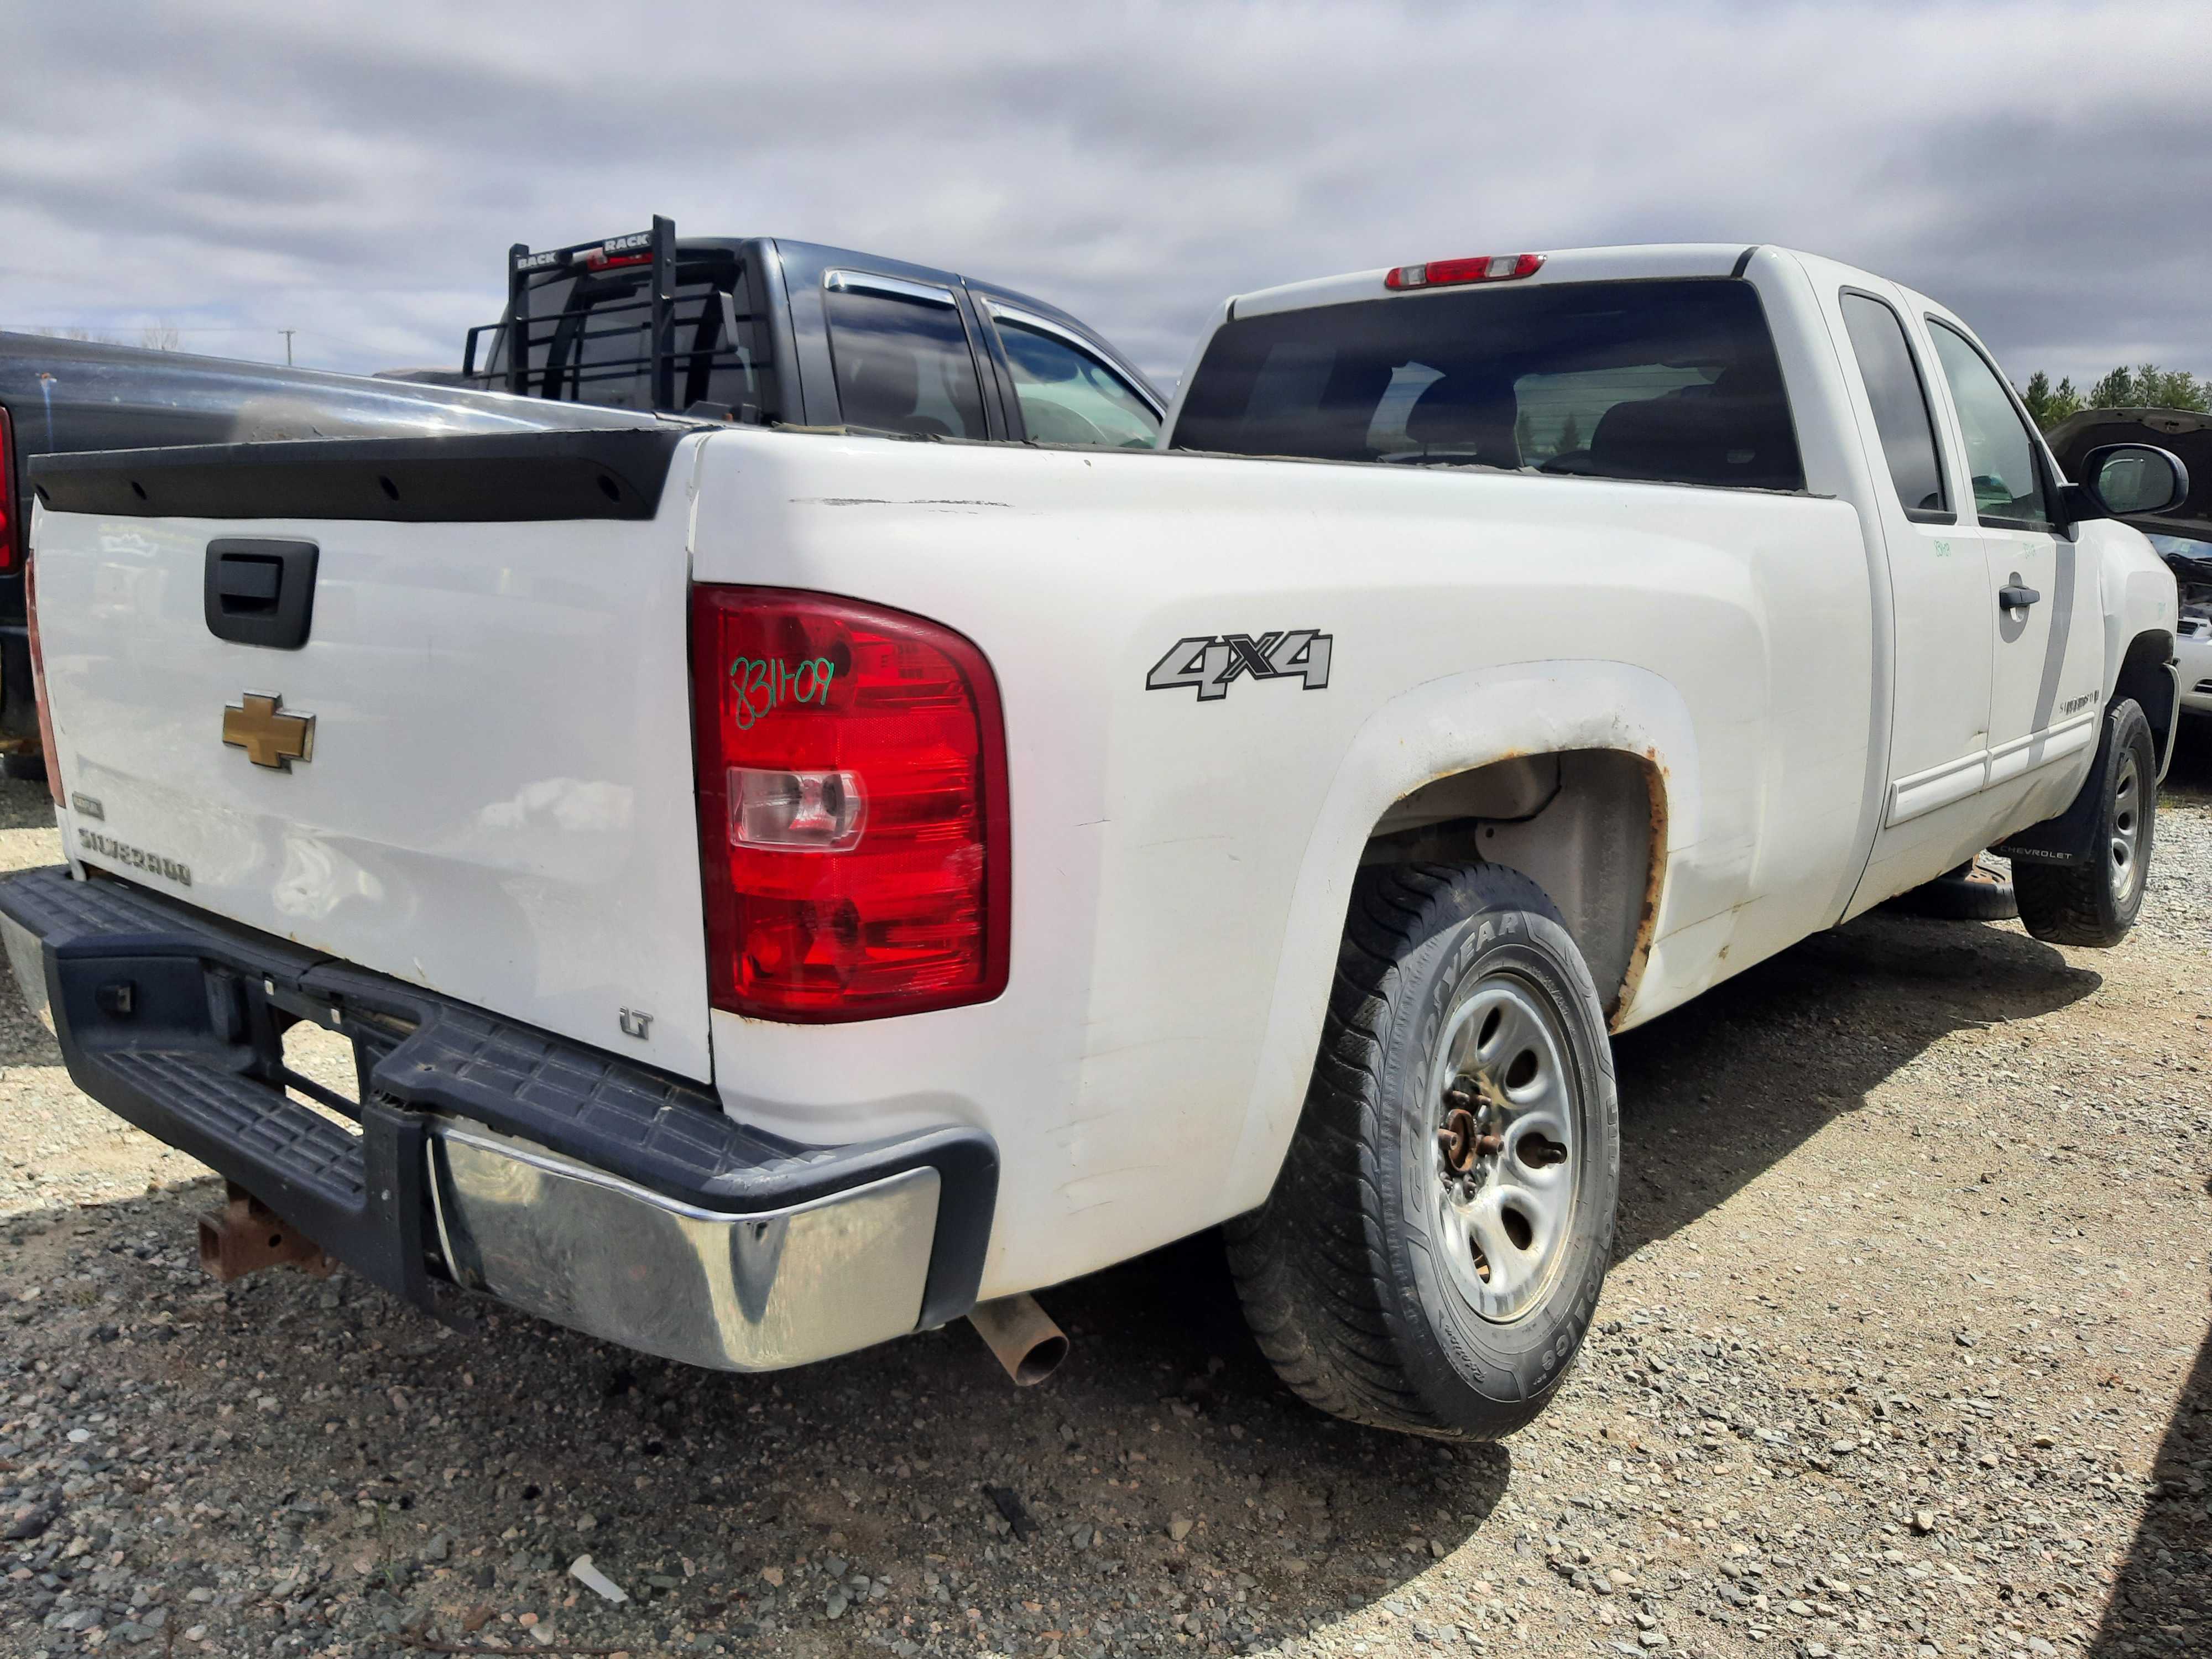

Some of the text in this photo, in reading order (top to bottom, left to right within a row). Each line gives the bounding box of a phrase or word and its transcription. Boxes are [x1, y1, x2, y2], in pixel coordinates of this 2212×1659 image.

[517, 233, 650, 269] BACK RACK
[78, 828, 191, 887] SILVERADO
[2000, 846, 2073, 859] CHEVROLET
[619, 1005, 654, 1040] LT
[1410, 912, 1520, 1213] GOODYEAR
